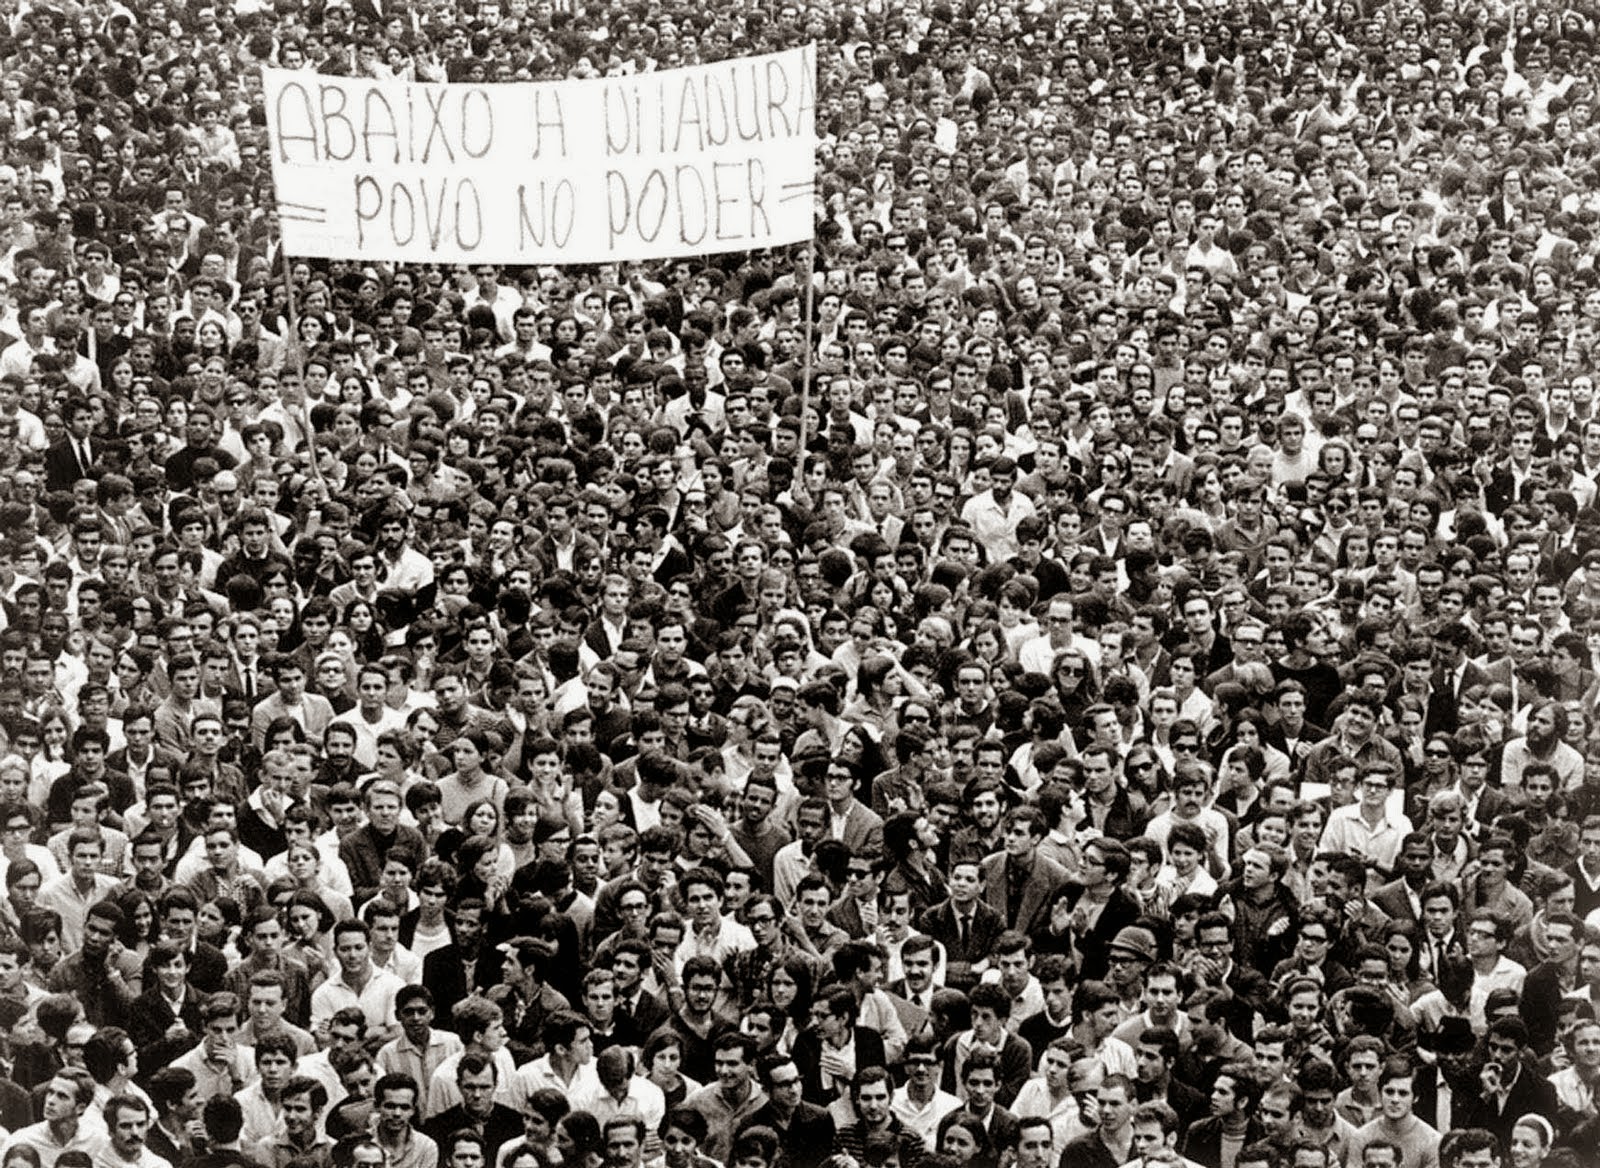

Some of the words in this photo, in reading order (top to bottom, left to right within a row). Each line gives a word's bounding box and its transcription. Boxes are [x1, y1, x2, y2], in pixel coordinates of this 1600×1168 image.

[531, 89, 566, 160] A
[354, 174, 482, 252] POVO
[518, 177, 575, 252] NO
[606, 158, 771, 250] PODER
